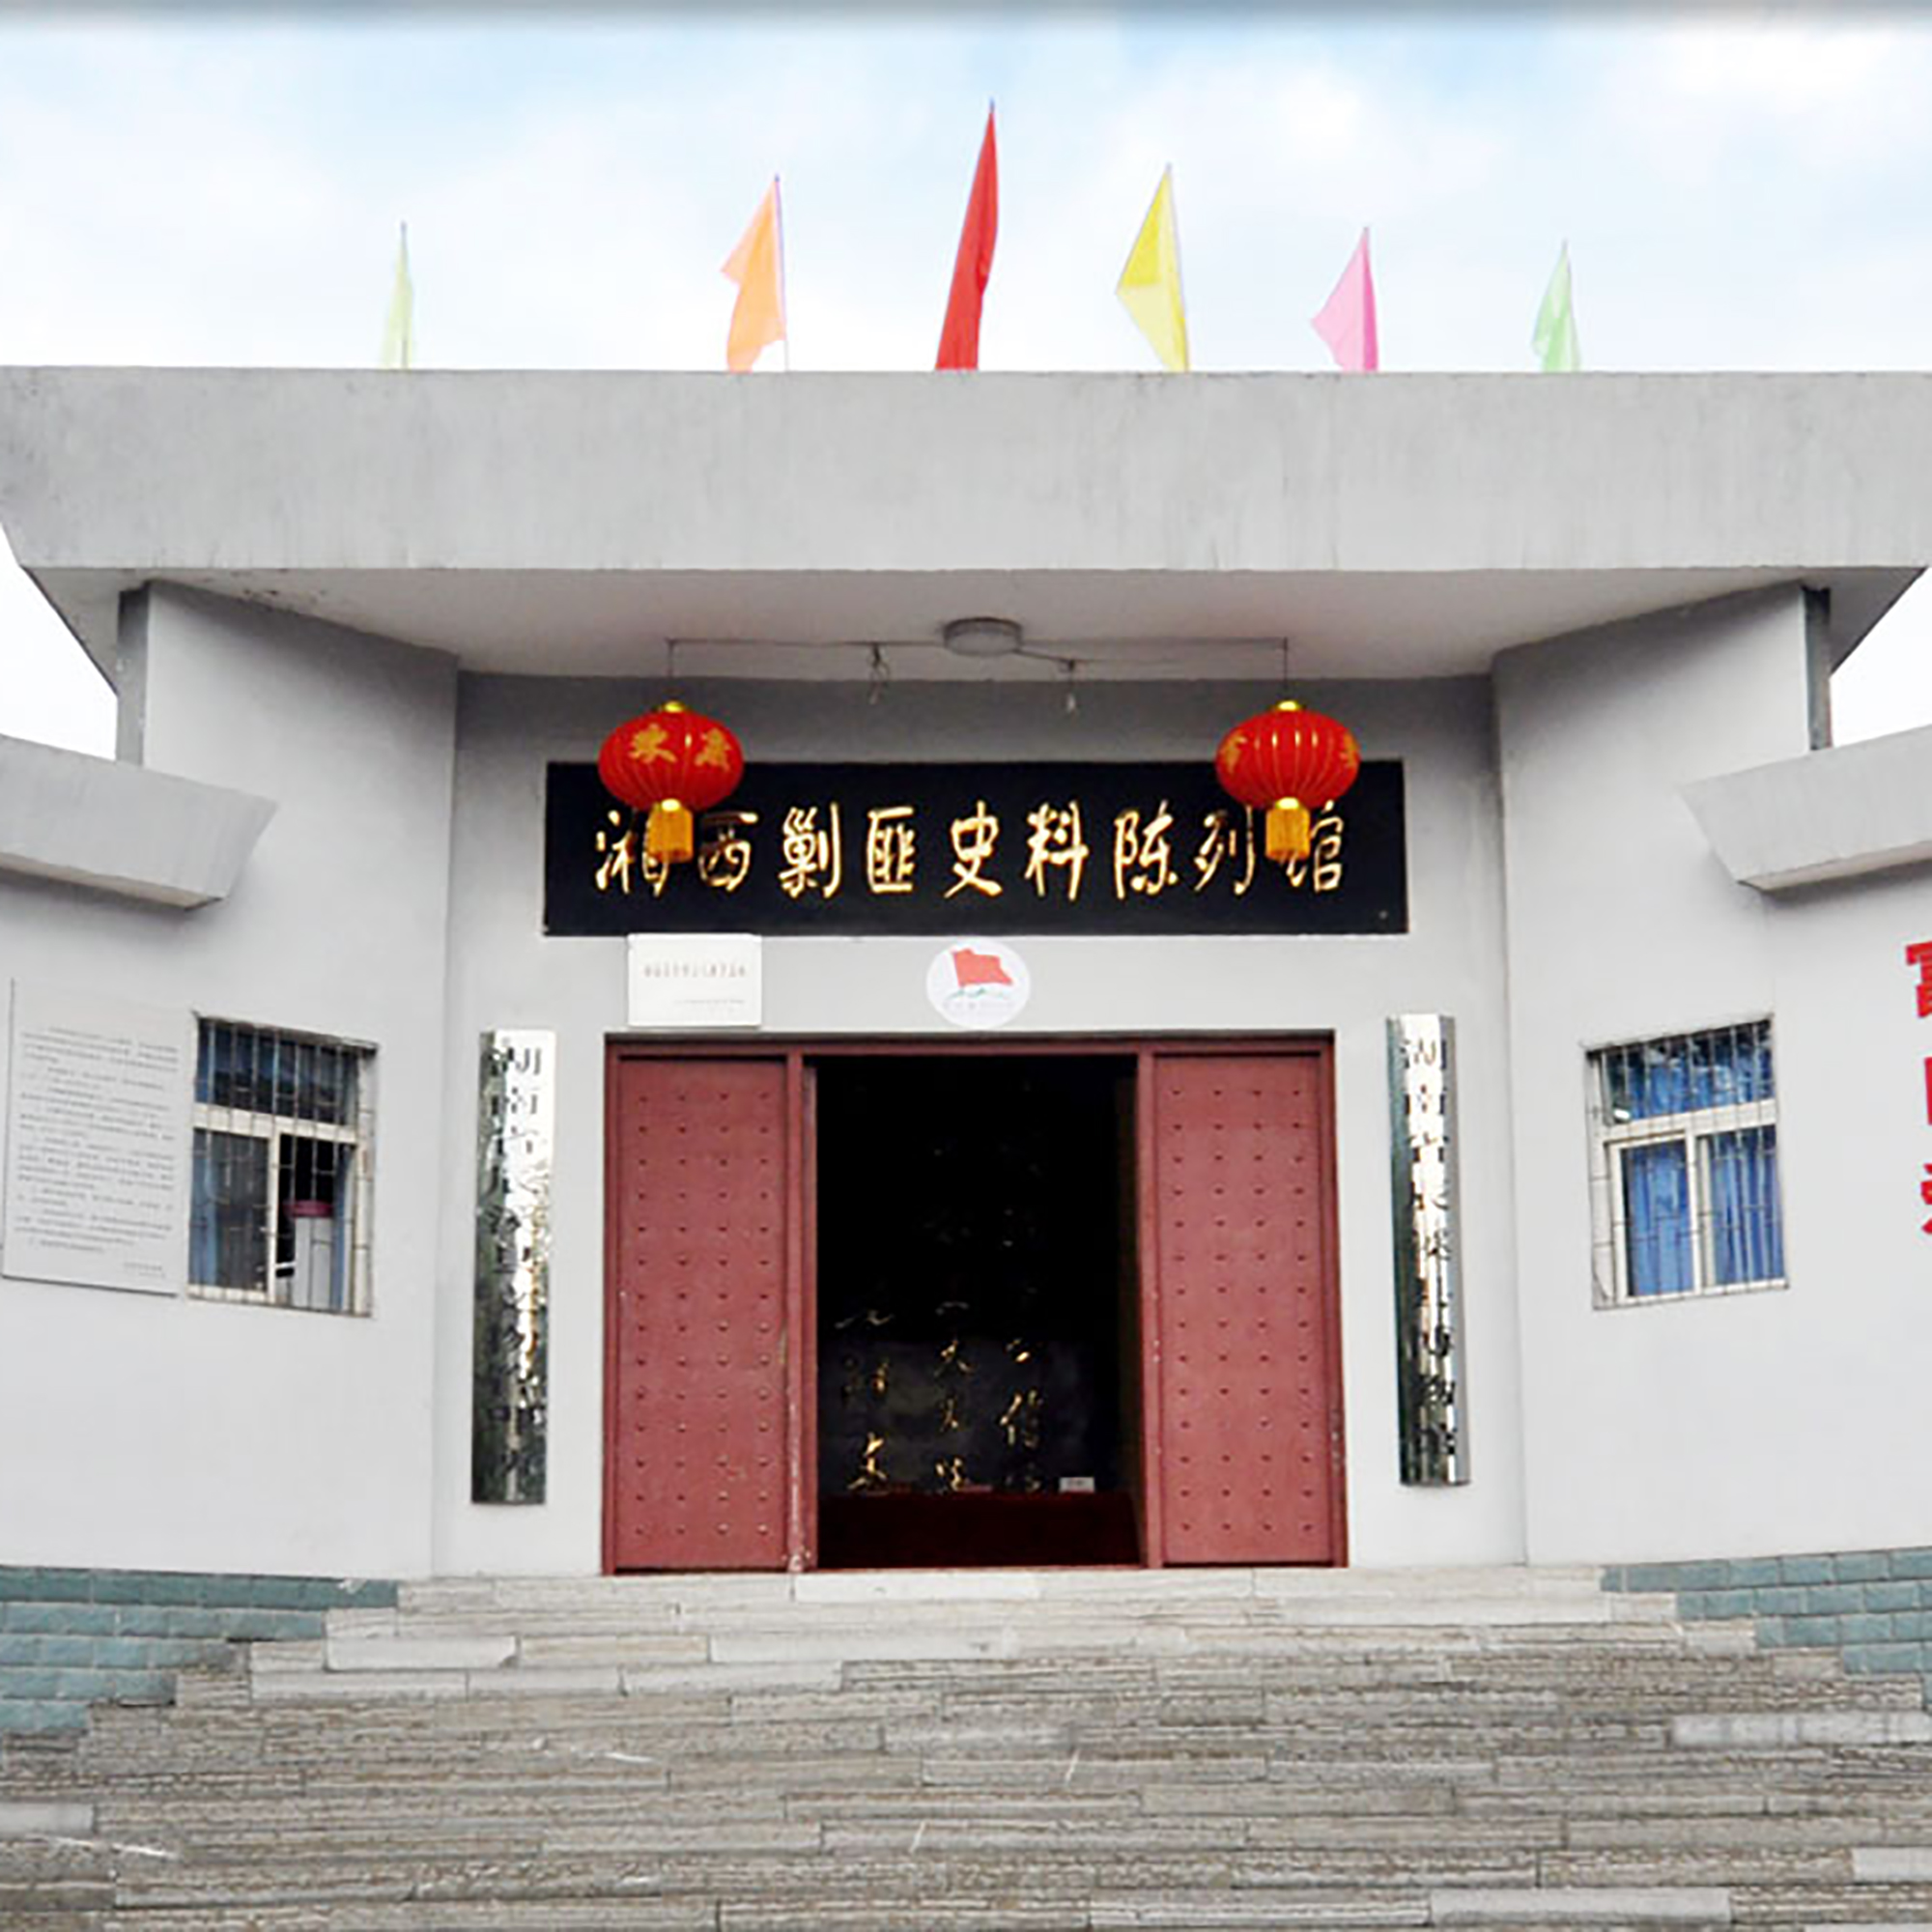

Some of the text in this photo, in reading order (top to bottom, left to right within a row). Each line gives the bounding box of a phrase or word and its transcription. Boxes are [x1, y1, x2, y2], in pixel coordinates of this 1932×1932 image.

[594, 799, 1344, 900] 湘西剿匪史料陈列馆
